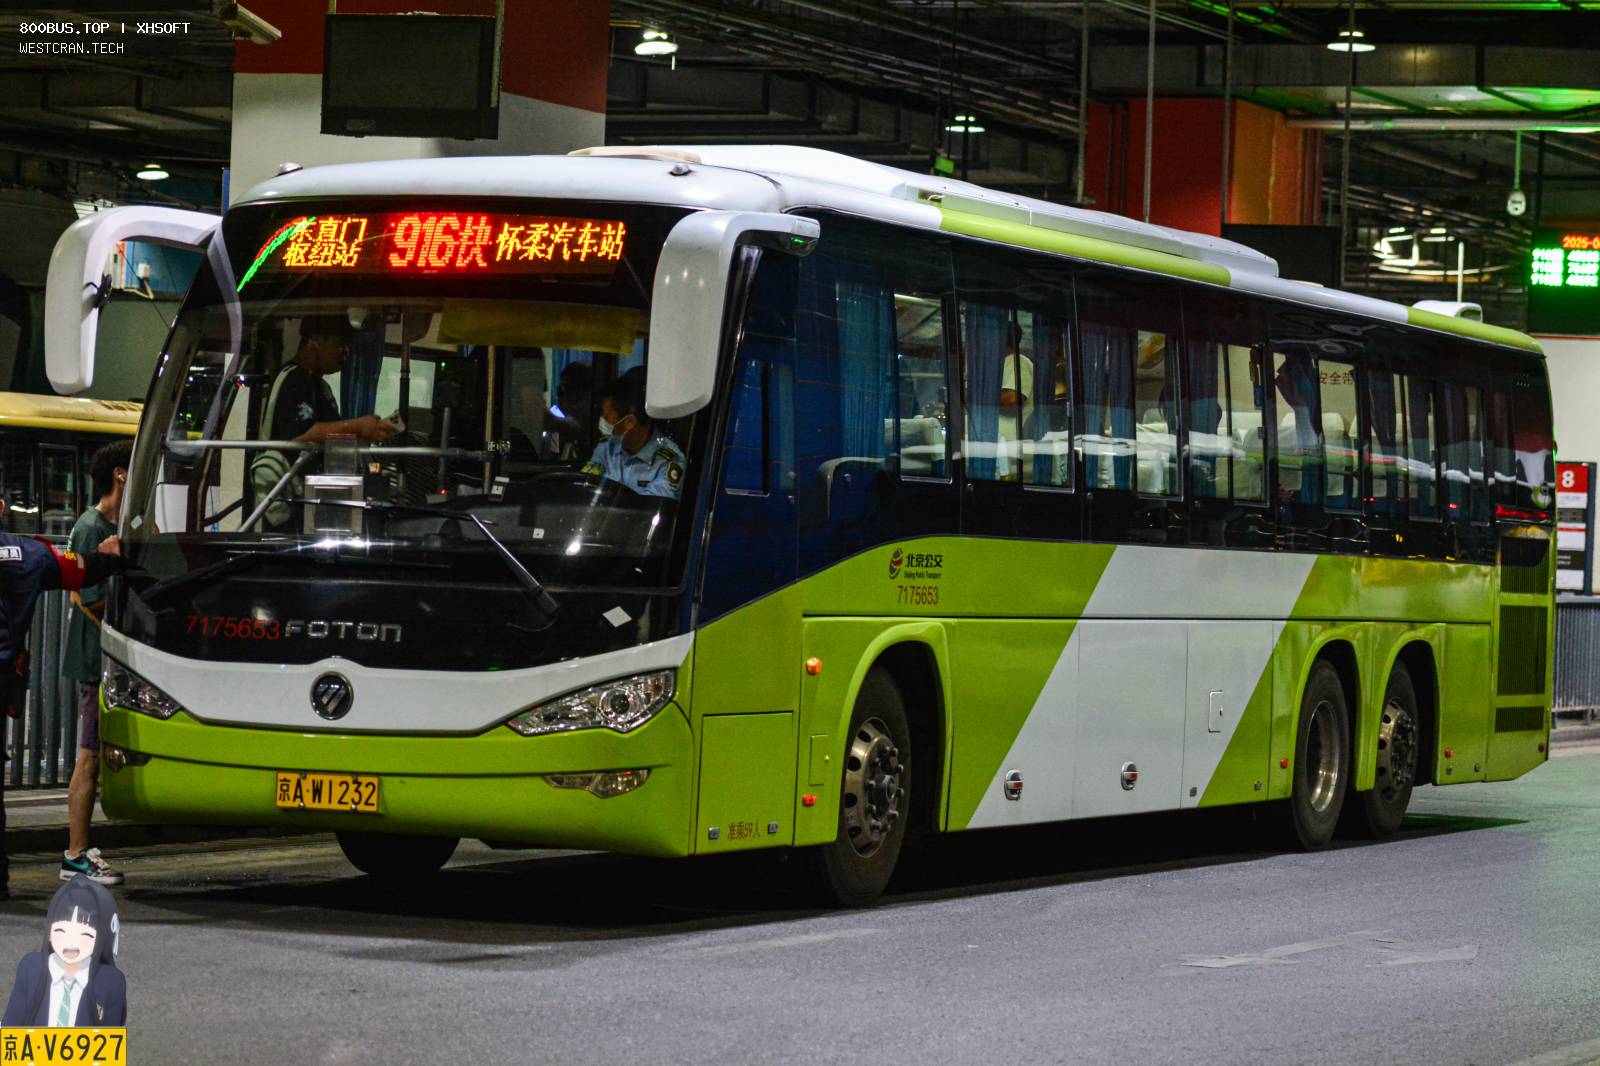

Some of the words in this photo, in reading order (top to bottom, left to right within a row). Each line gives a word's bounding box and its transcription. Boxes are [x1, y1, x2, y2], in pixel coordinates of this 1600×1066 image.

[389, 216, 492, 268] 916快
[496, 221, 626, 262] 怀柔汽车站
[1563, 236, 1600, 250] 2025-0
[283, 243, 361, 267] 枢纽站
[1561, 469, 1575, 488] 8
[905, 553, 943, 568] 北京公交
[897, 585, 939, 605] 7175653
[186, 615, 281, 641] 7175653
[285, 620, 401, 642] FOTON
